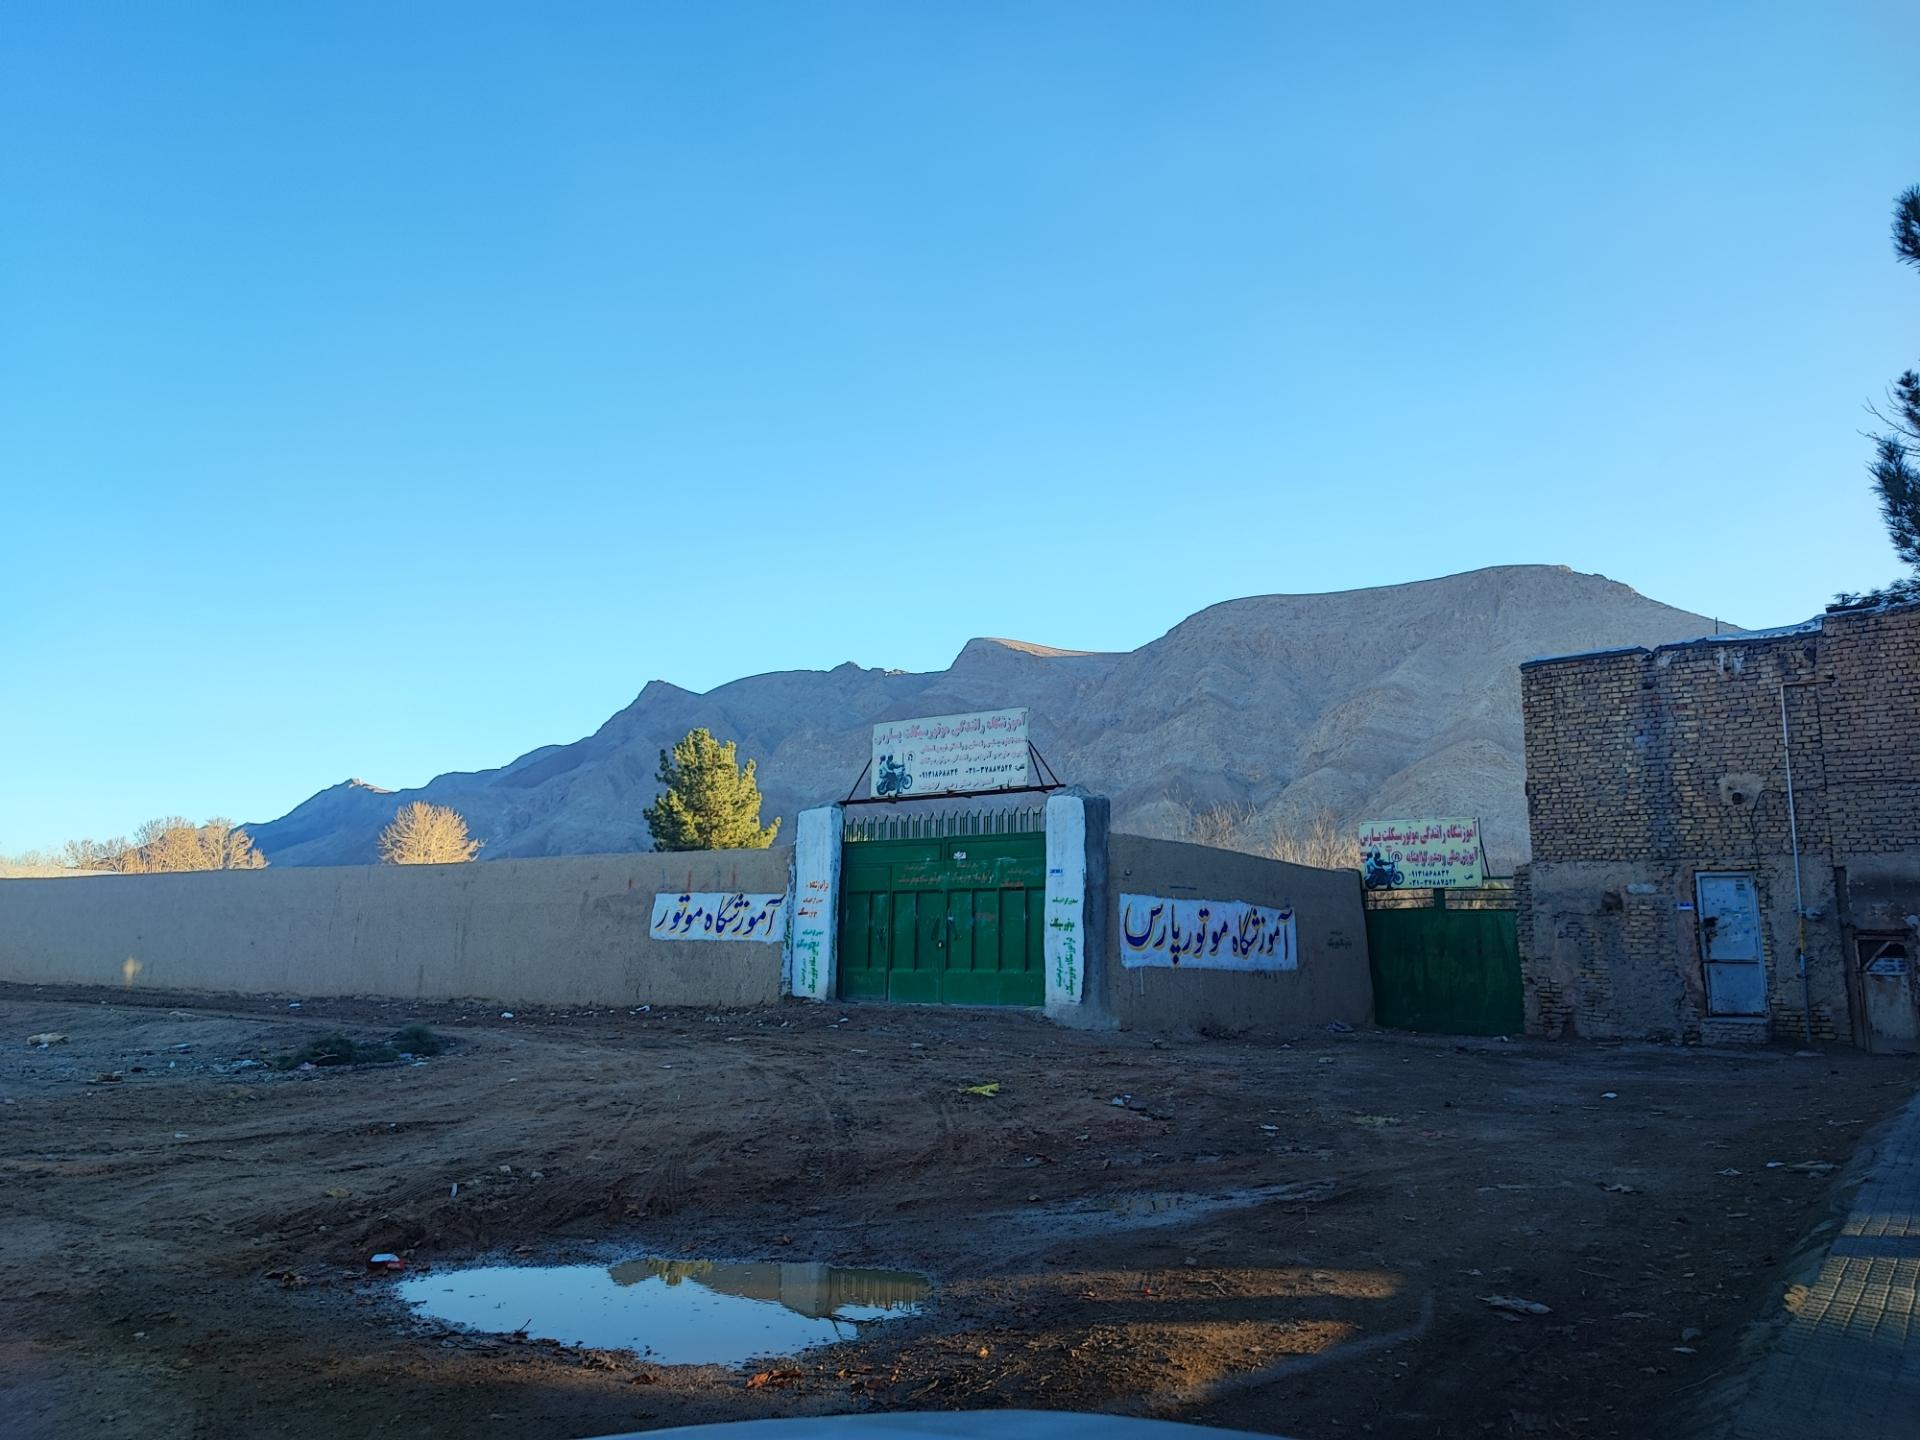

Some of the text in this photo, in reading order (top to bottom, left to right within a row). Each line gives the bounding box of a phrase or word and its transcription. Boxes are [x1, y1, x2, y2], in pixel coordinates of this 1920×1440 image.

[654, 894, 703, 934] موتور
[704, 893, 787, 936] آموزشگاه
[1123, 903, 1294, 966] آموزشگاه موتور پارس
